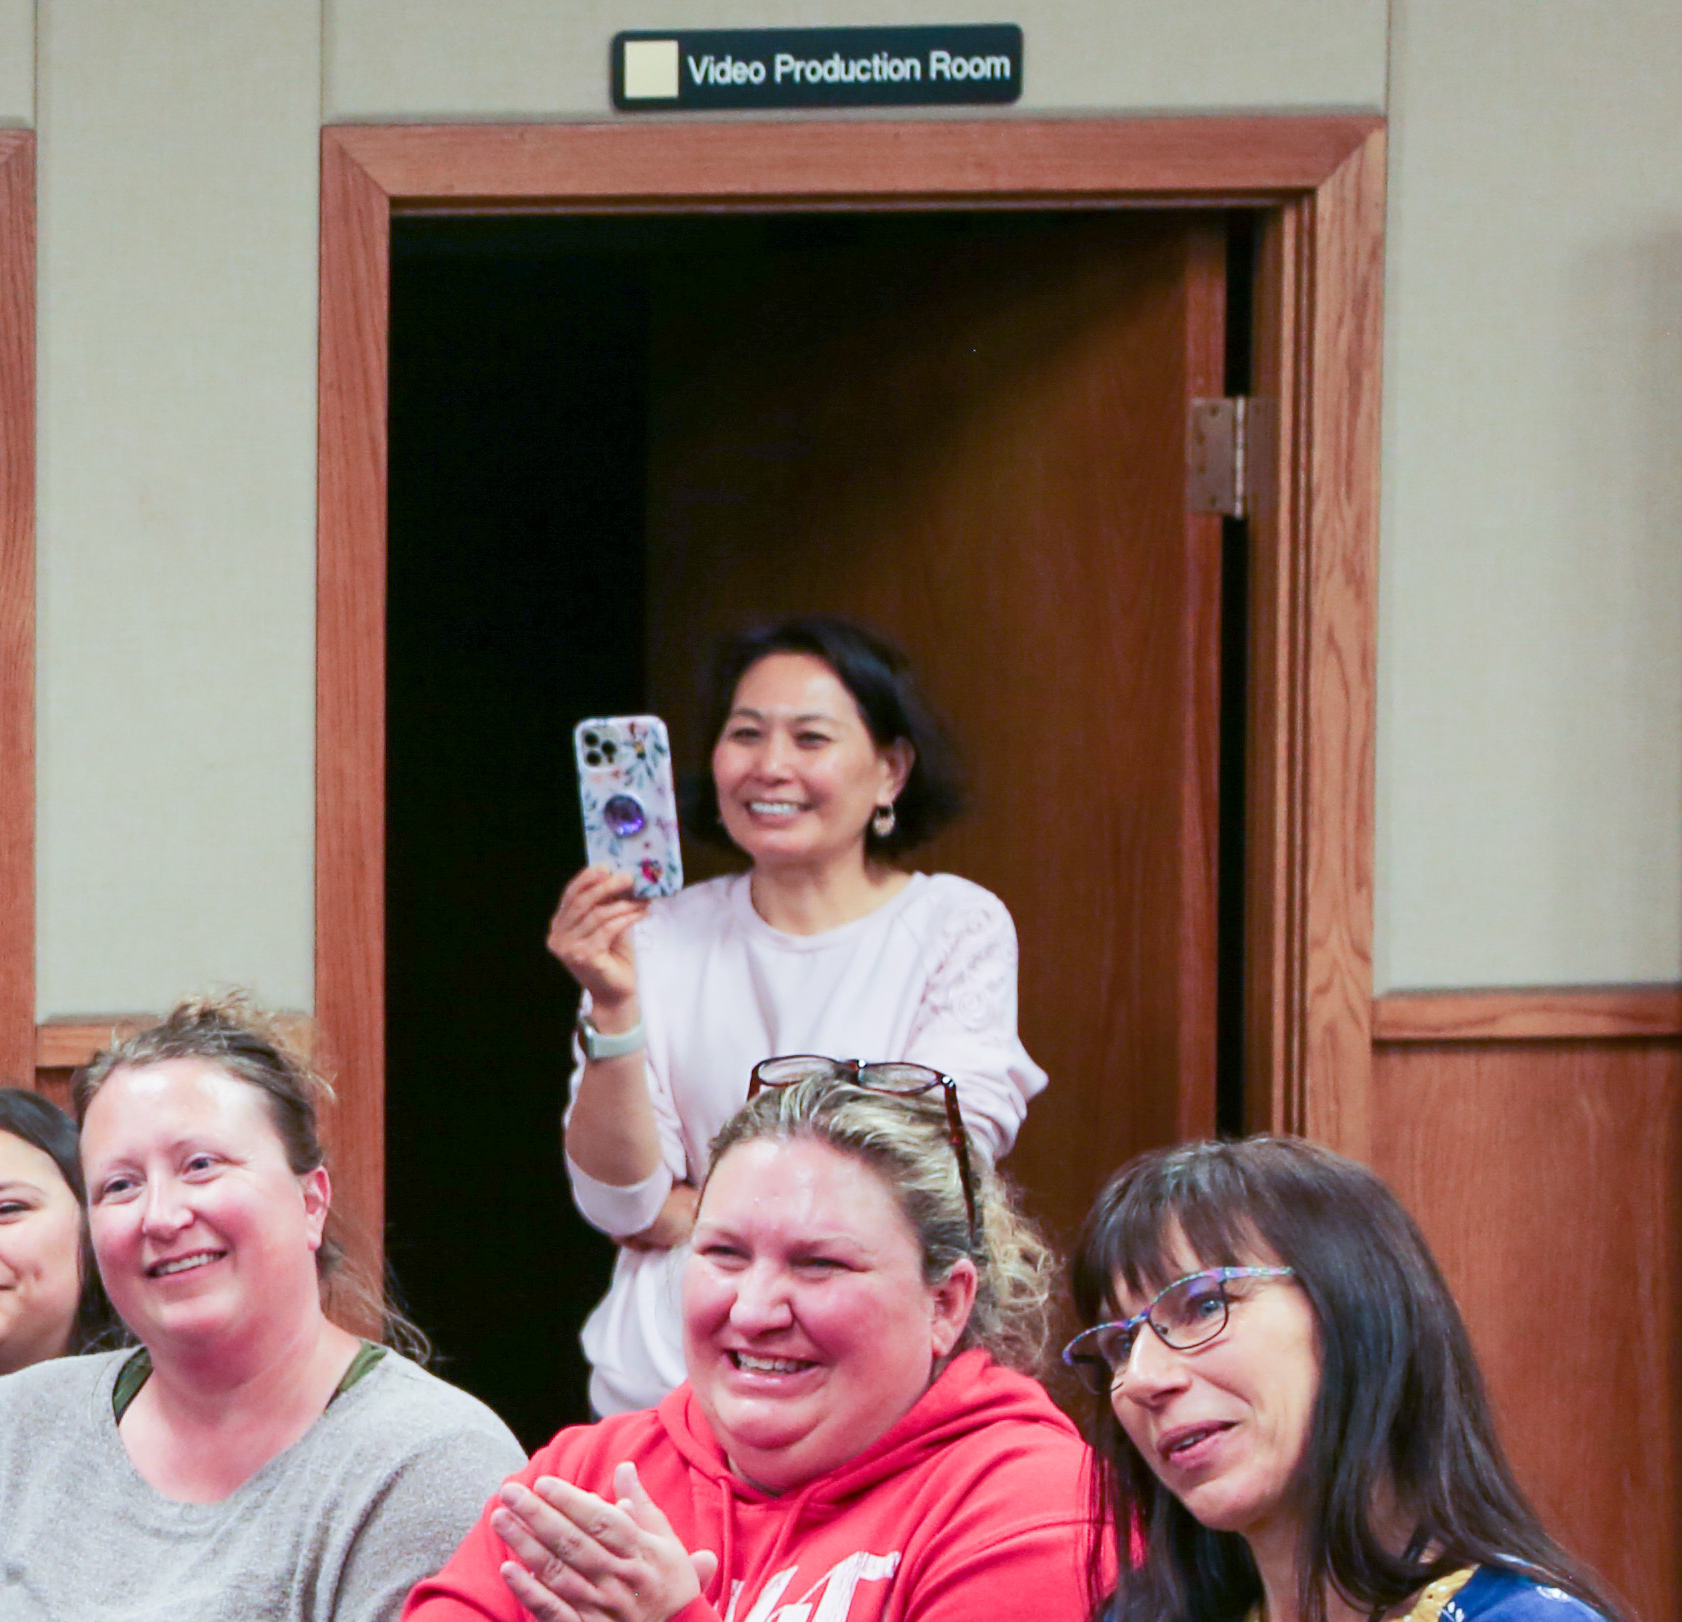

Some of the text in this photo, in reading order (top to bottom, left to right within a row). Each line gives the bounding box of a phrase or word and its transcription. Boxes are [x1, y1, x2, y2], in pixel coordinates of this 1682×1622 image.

[687, 50, 1011, 85] Video Production Room
